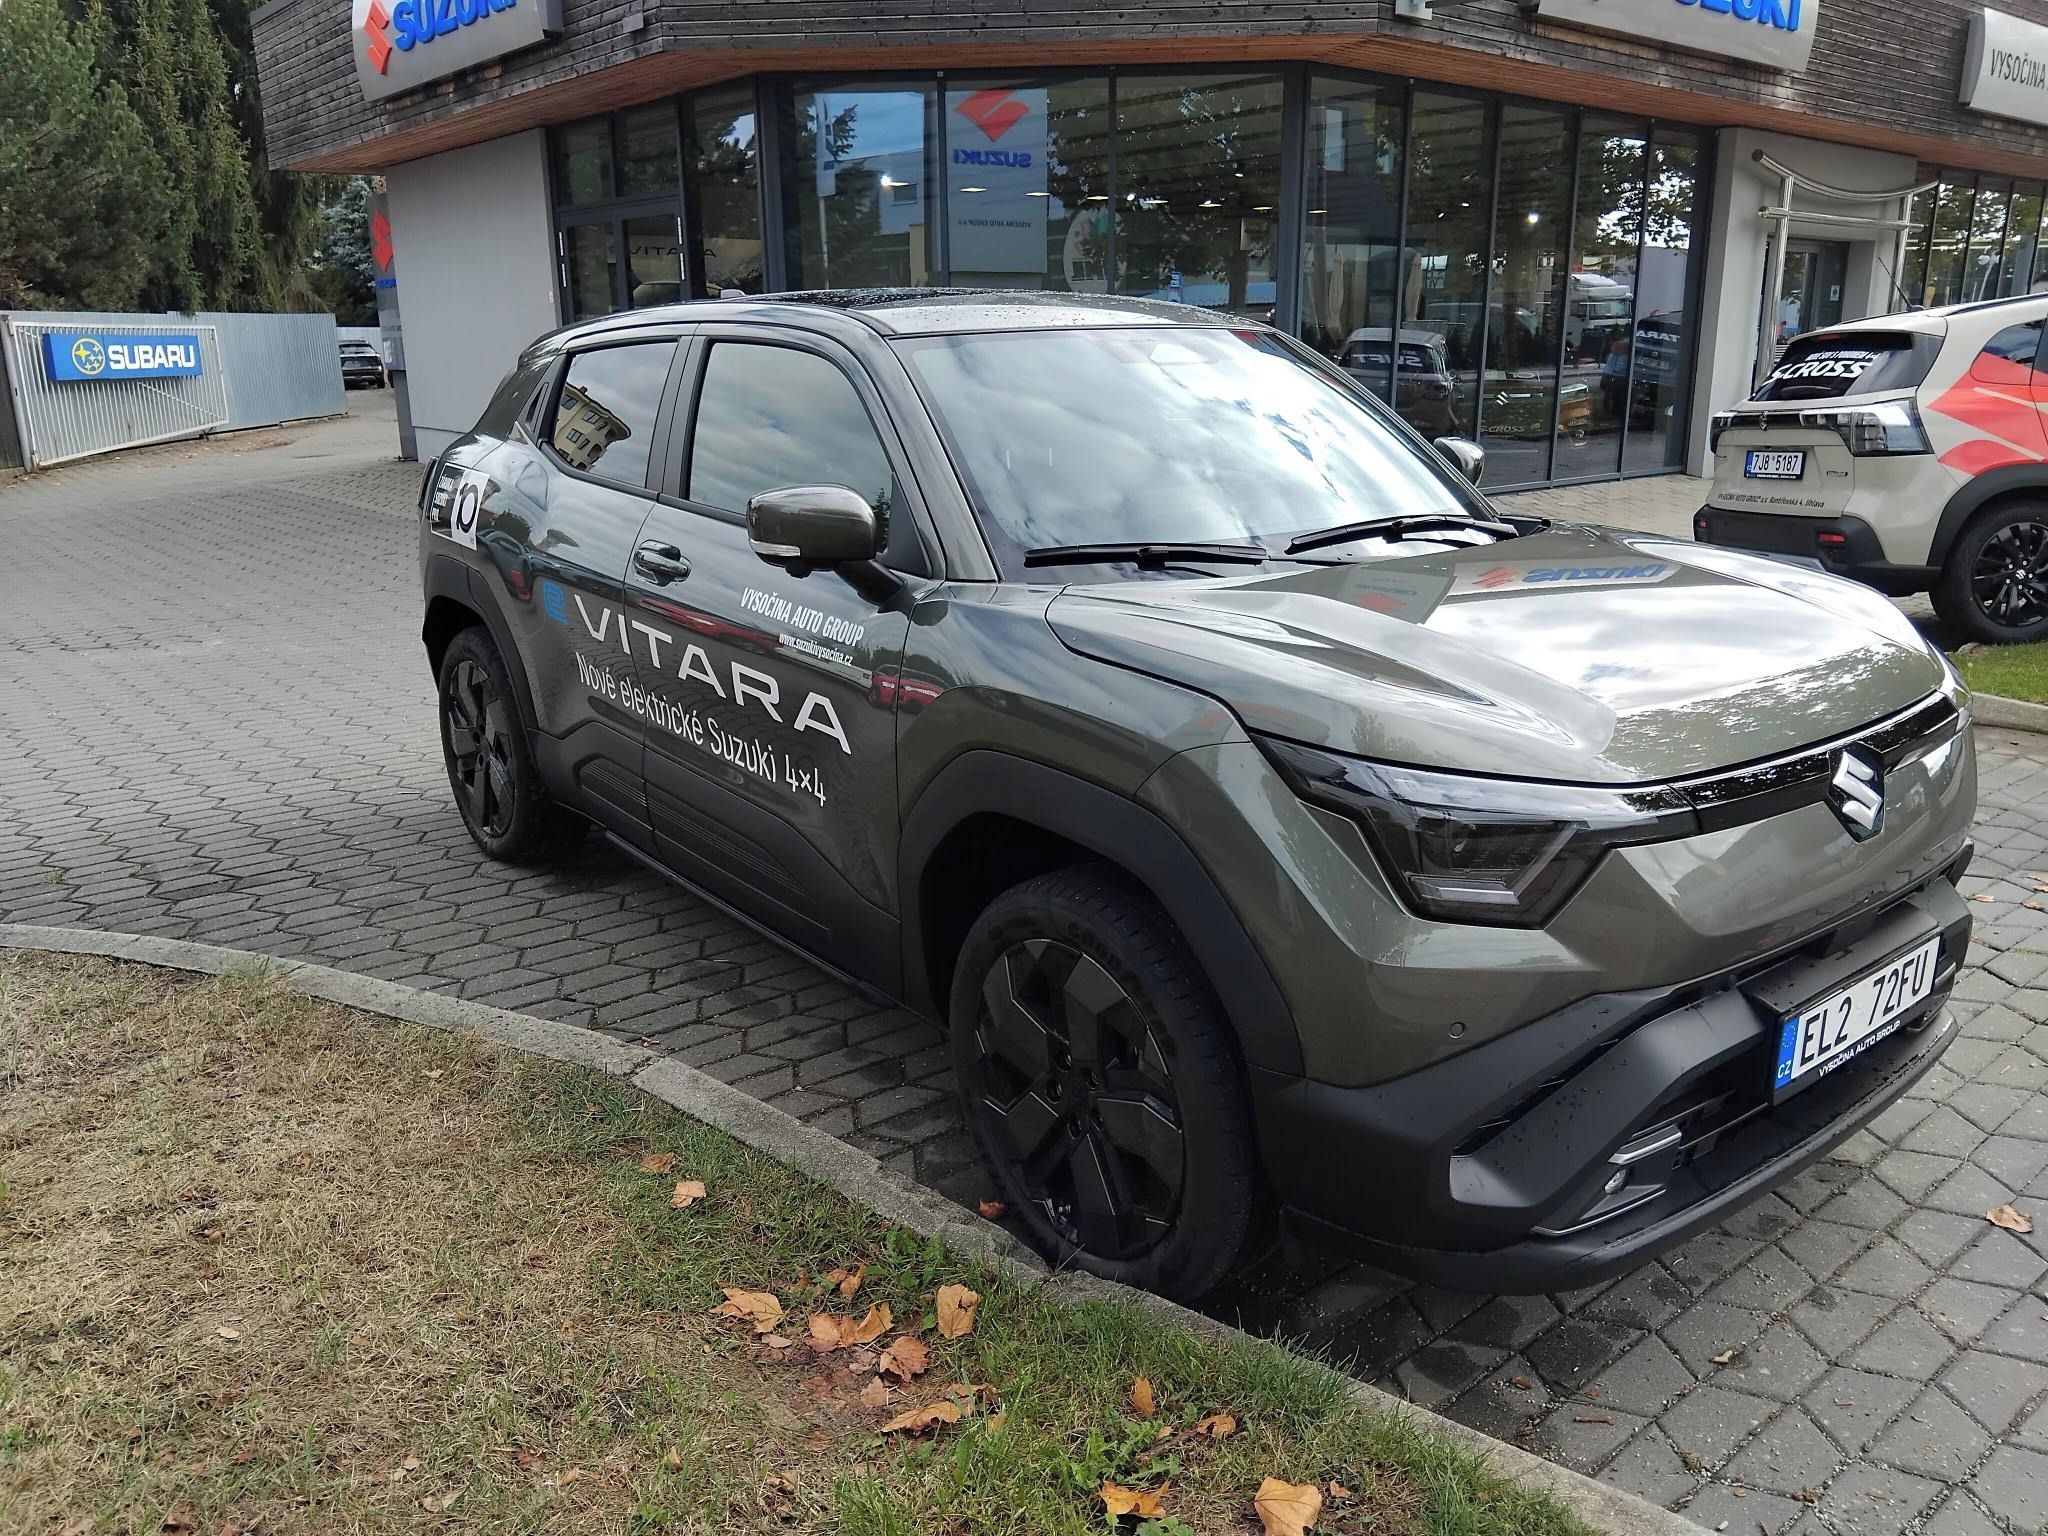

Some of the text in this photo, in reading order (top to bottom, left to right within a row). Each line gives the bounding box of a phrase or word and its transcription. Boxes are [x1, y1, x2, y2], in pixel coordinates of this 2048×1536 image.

[393, 0, 517, 51] SUZU
[1990, 48, 2046, 90] VYSOČINA
[107, 344, 196, 371] SUBARU
[1753, 454, 1769, 471] 7J8
[1775, 454, 1798, 472] 5187
[740, 587, 865, 647] VYSOČINA AUTO GROUP
[574, 593, 852, 755] VITARA
[778, 633, 854, 667] www.suzukivysocina.cz
[575, 651, 617, 701] Nové
[620, 677, 705, 746] elektrické
[707, 717, 777, 783] Suzuki
[1777, 949, 1930, 1079] CZ EL2 72FU
[1818, 1020, 1901, 1078] VYSOČINA AUTO GROUP
